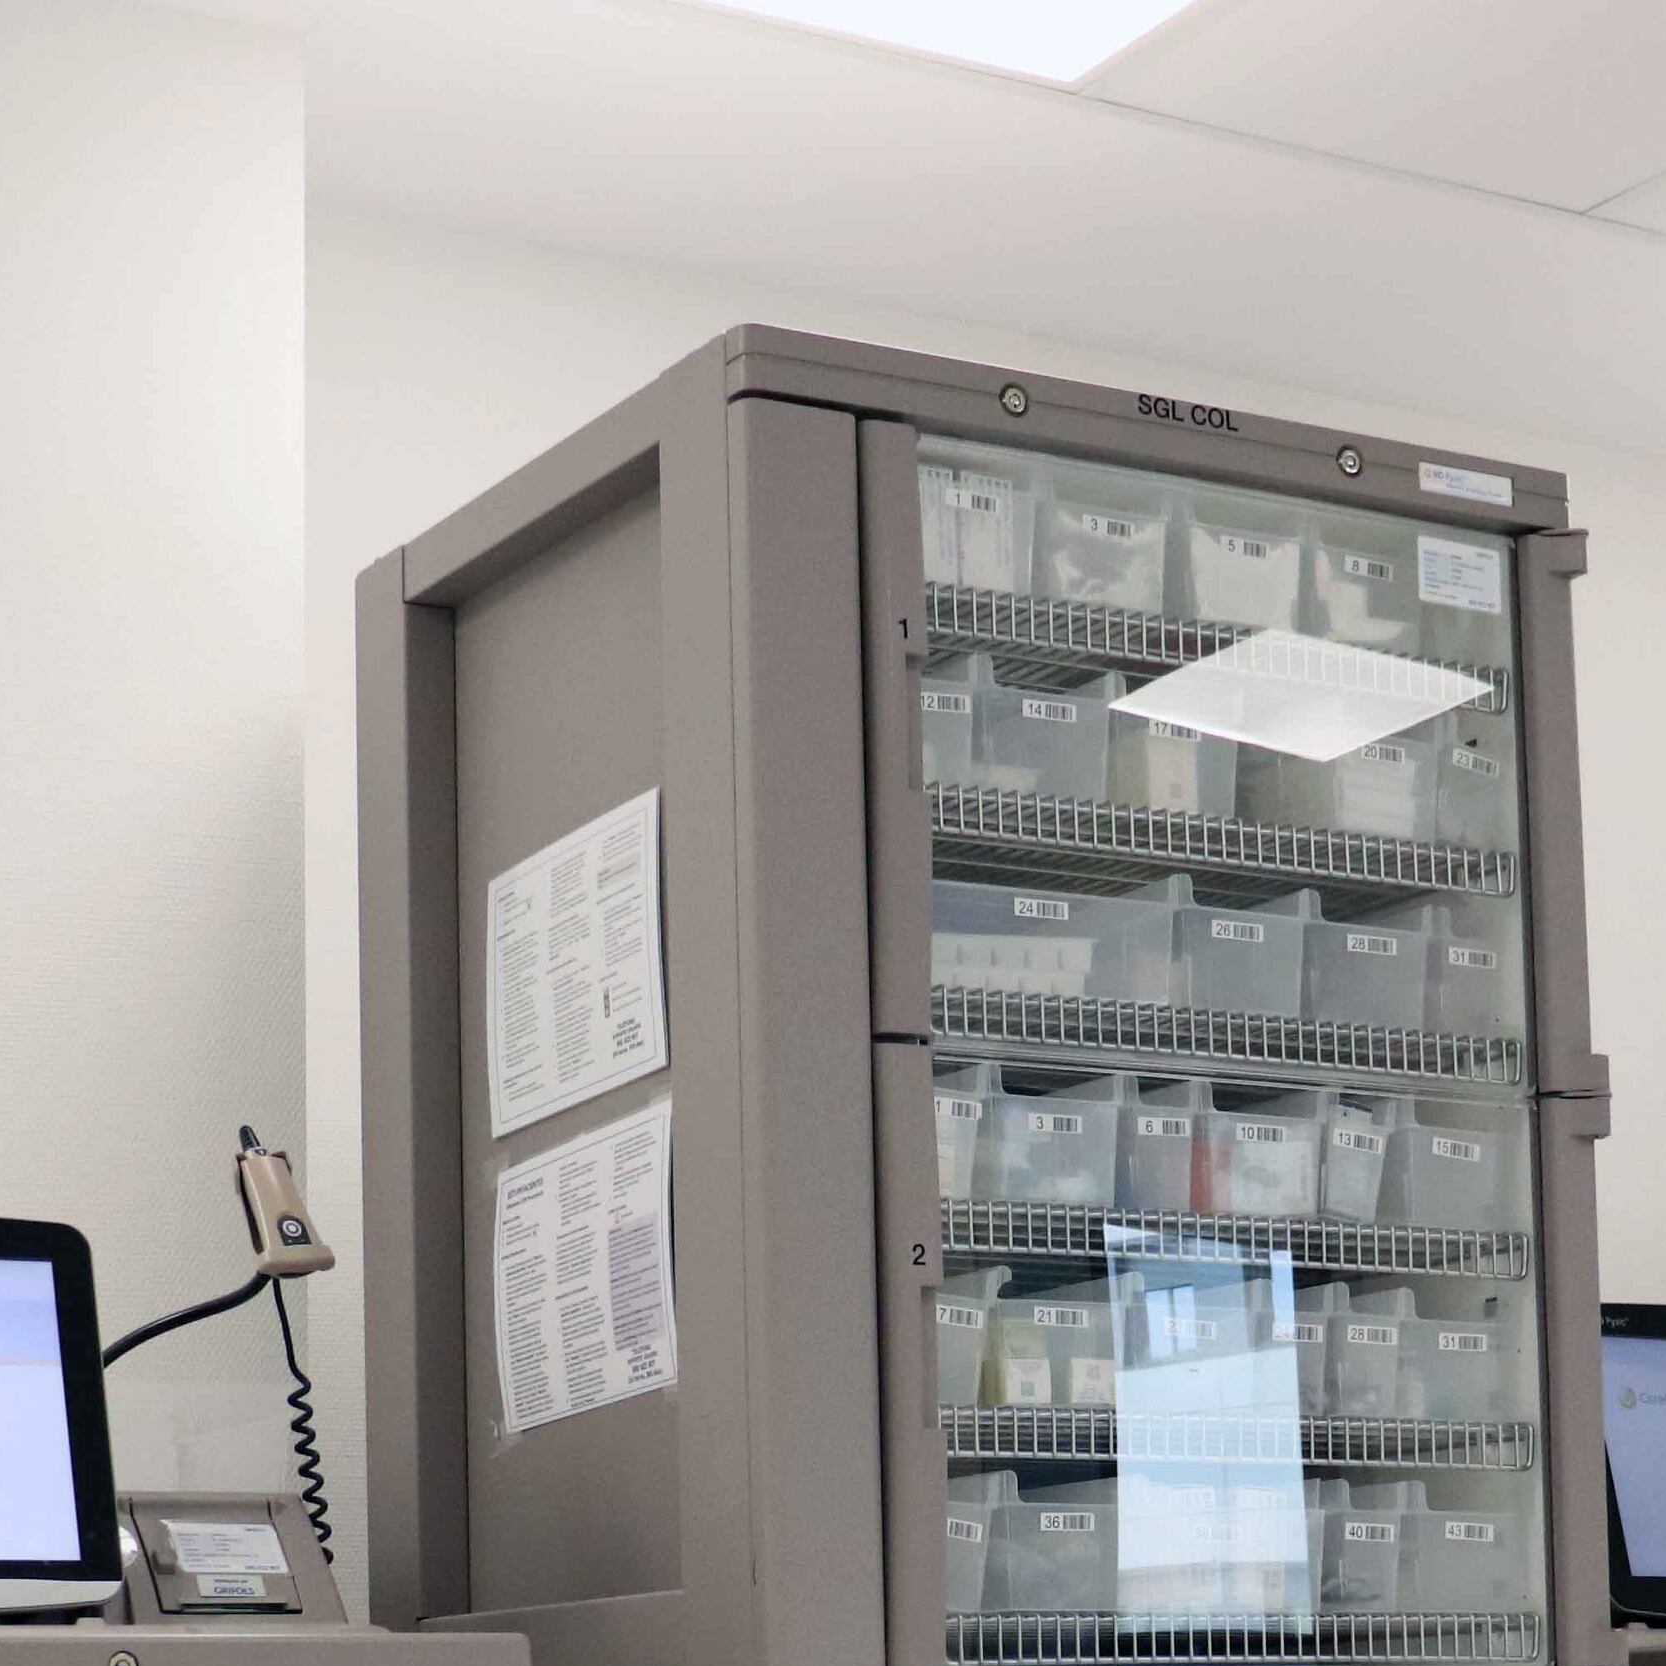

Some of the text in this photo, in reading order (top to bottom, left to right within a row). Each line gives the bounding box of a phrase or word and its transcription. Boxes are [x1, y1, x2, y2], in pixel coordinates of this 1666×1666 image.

[1138, 393, 1239, 432] SGL COL
[954, 493, 961, 505] 1
[1091, 518, 1099, 531] 3
[1228, 540, 1235, 552] 5
[1352, 560, 1359, 572] 8
[899, 618, 908, 639] 1
[921, 695, 935, 708] 12
[1028, 703, 1042, 716] 14
[1155, 721, 1168, 734] 17
[1364, 745, 1377, 758] 20
[1456, 752, 1470, 766] 23
[1019, 901, 1034, 916] 24
[1215, 923, 1232, 938] 26
[1351, 937, 1366, 951] 28
[1452, 950, 1467, 964] 31
[935, 1101, 941, 1112] 1
[1036, 1116, 1045, 1130] 3
[1145, 1120, 1153, 1133] 6
[1241, 1126, 1255, 1139] 10
[1337, 1132, 1352, 1146] 13
[1435, 1140, 1449, 1154] 15
[912, 1245, 927, 1266] 2
[939, 1307, 947, 1320] 7
[1037, 1309, 1052, 1323] 21
[1349, 1327, 1365, 1341] 28
[1442, 1334, 1456, 1349] 31
[1044, 1513, 1061, 1529] 36
[1348, 1525, 1363, 1539] 40
[1448, 1524, 1462, 1538] 43
